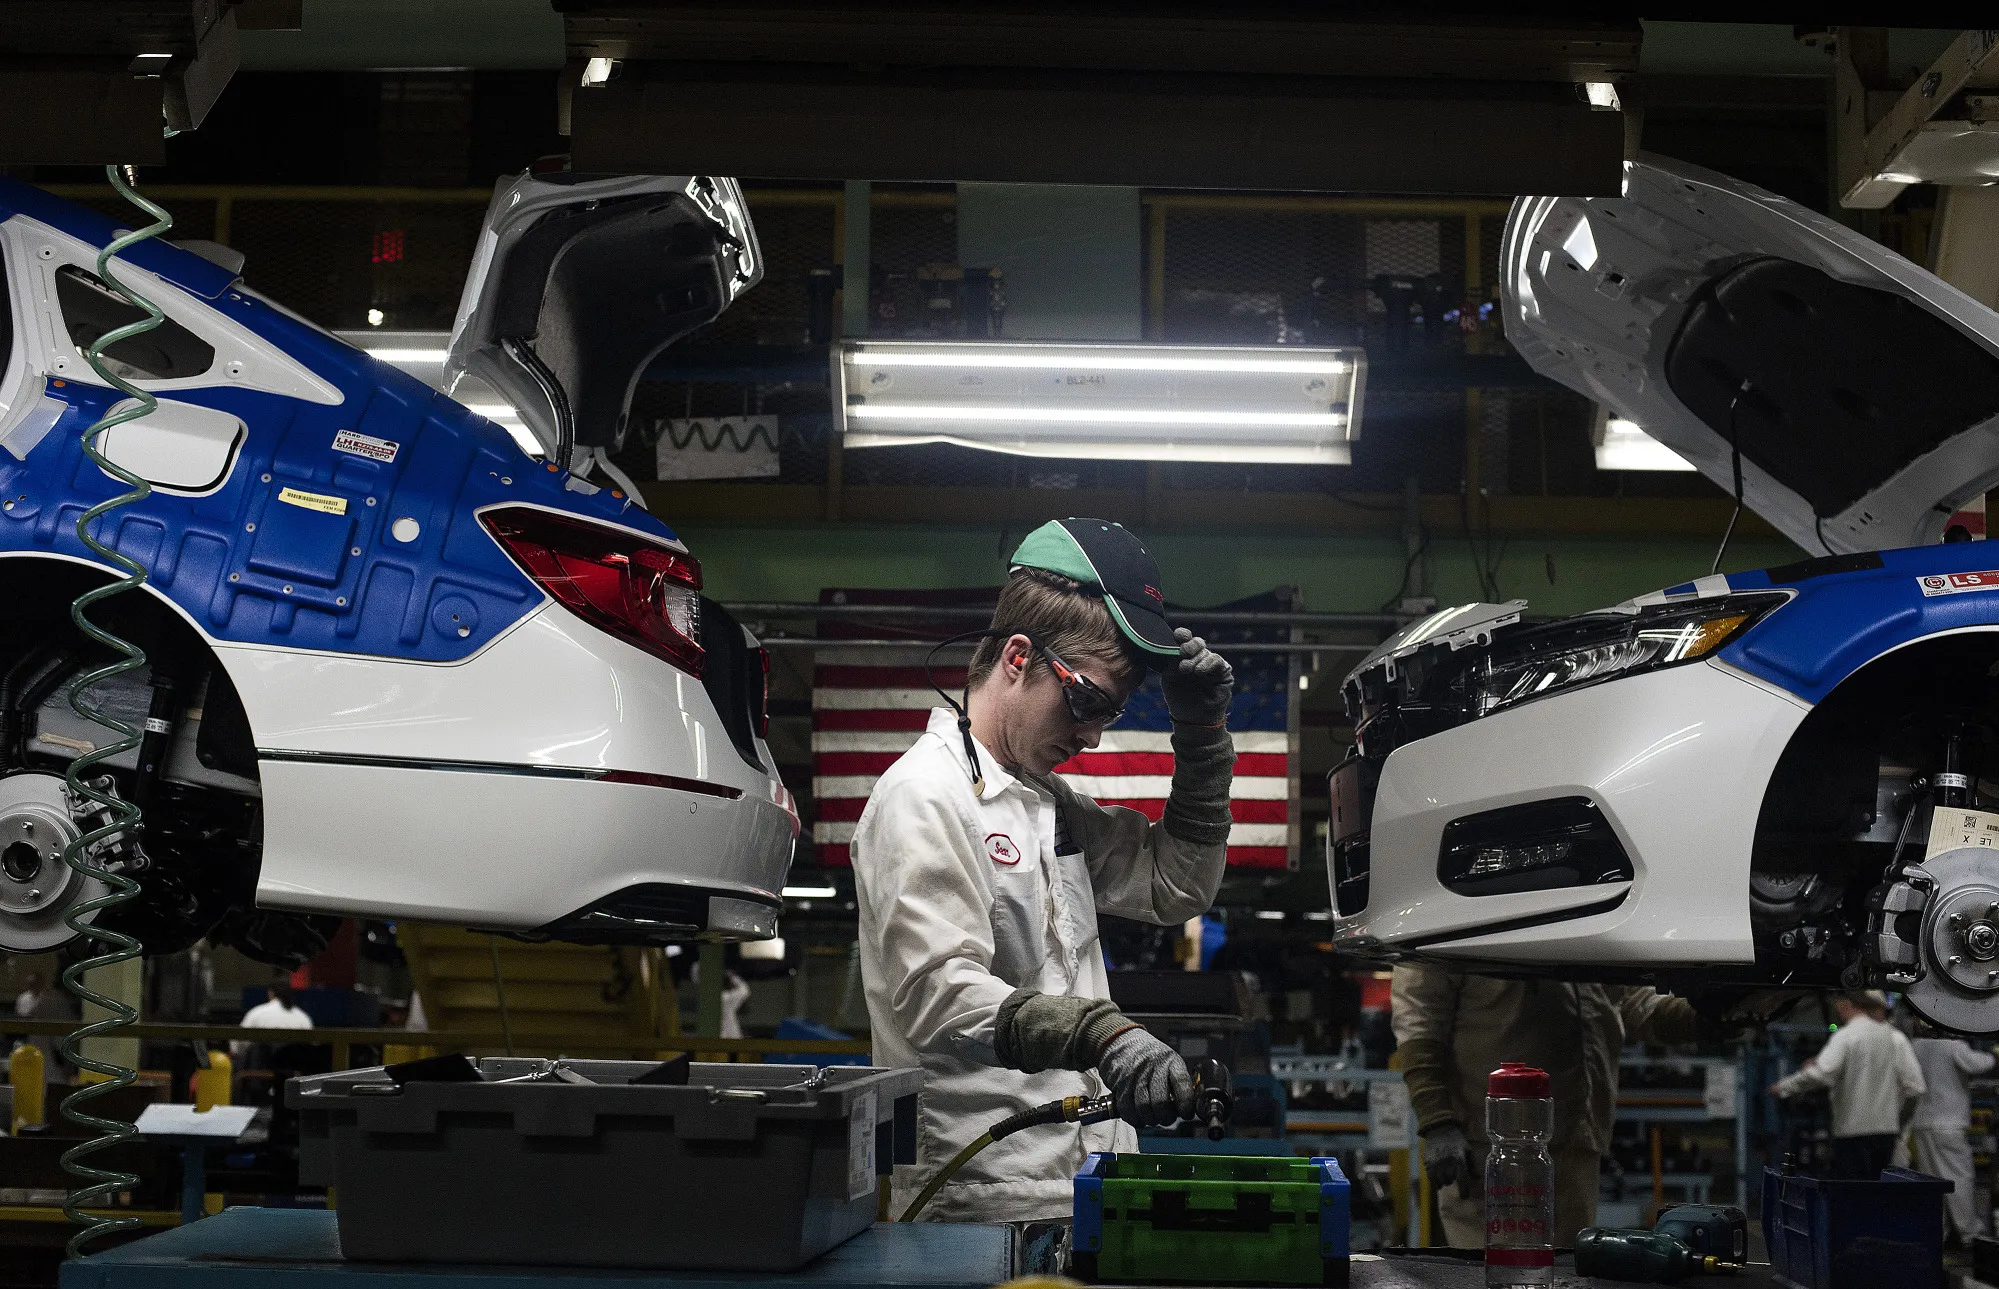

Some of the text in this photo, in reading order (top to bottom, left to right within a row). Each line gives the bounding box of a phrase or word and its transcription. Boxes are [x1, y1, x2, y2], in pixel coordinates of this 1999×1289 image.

[336, 437, 353, 446] LH
[1952, 574, 1982, 586] LS
[1962, 834, 1992, 847] LE X
